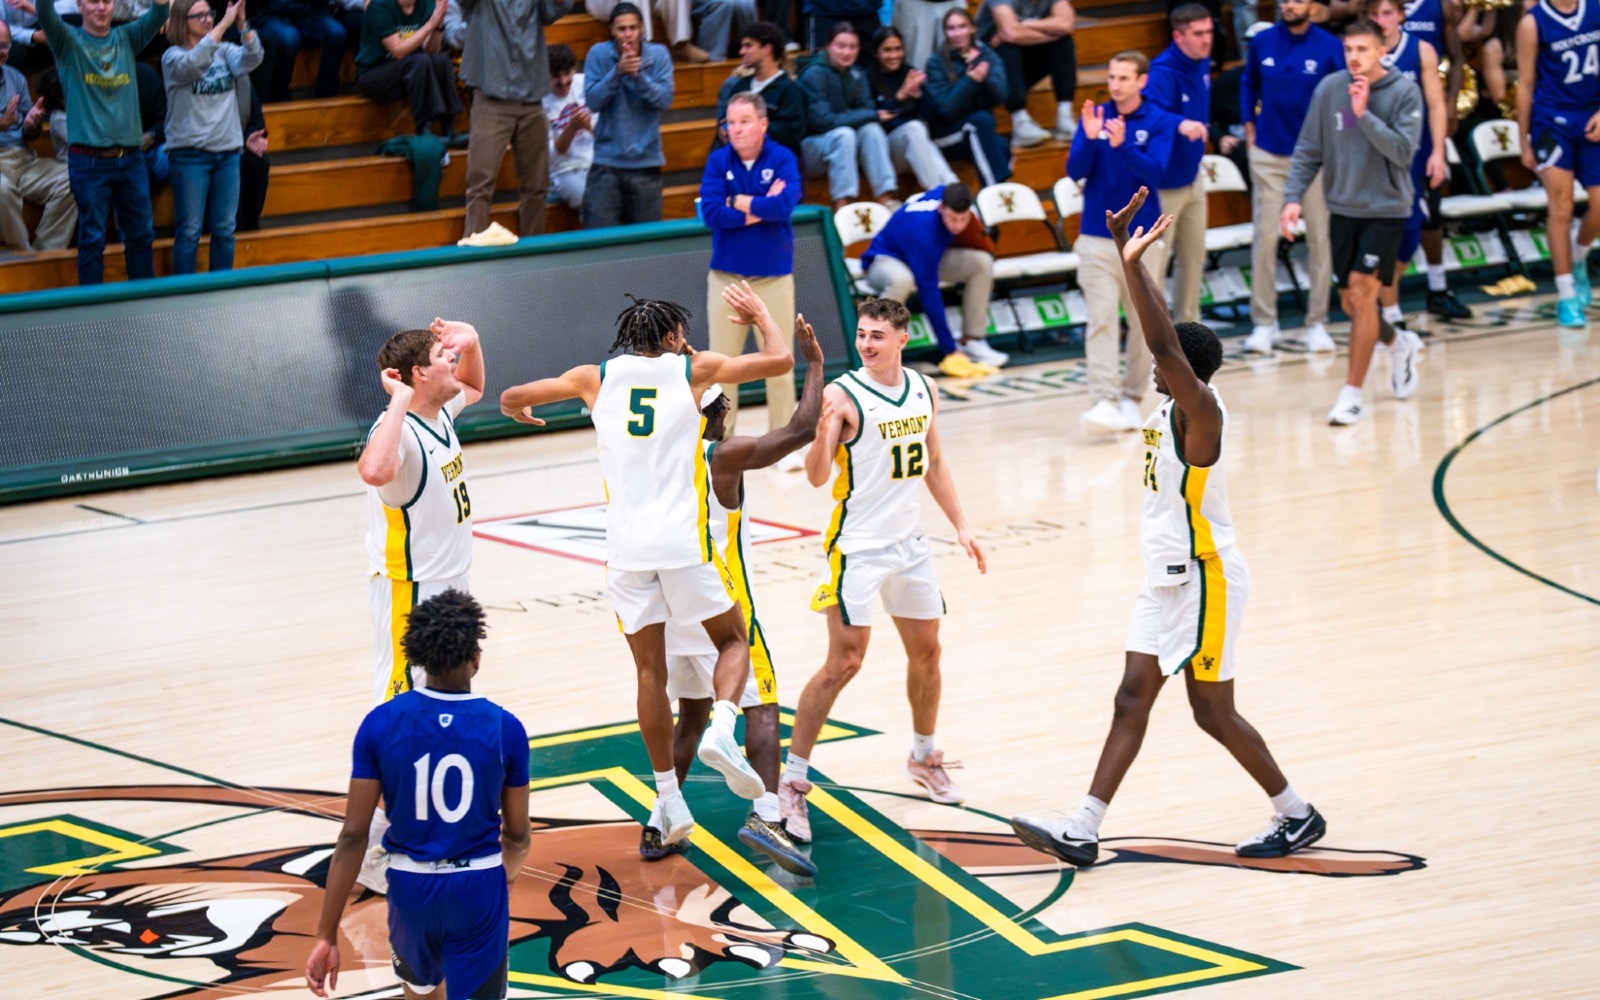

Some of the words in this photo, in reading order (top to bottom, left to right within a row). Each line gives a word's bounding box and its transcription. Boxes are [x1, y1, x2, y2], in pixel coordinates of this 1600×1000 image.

[1560, 44, 1600, 84] 24
[627, 386, 659, 438] 5
[878, 415, 928, 440] VERMONT
[440, 451, 464, 484] VERMON
[890, 442, 924, 479] 12
[453, 480, 471, 526] 19
[413, 752, 475, 824] 10
